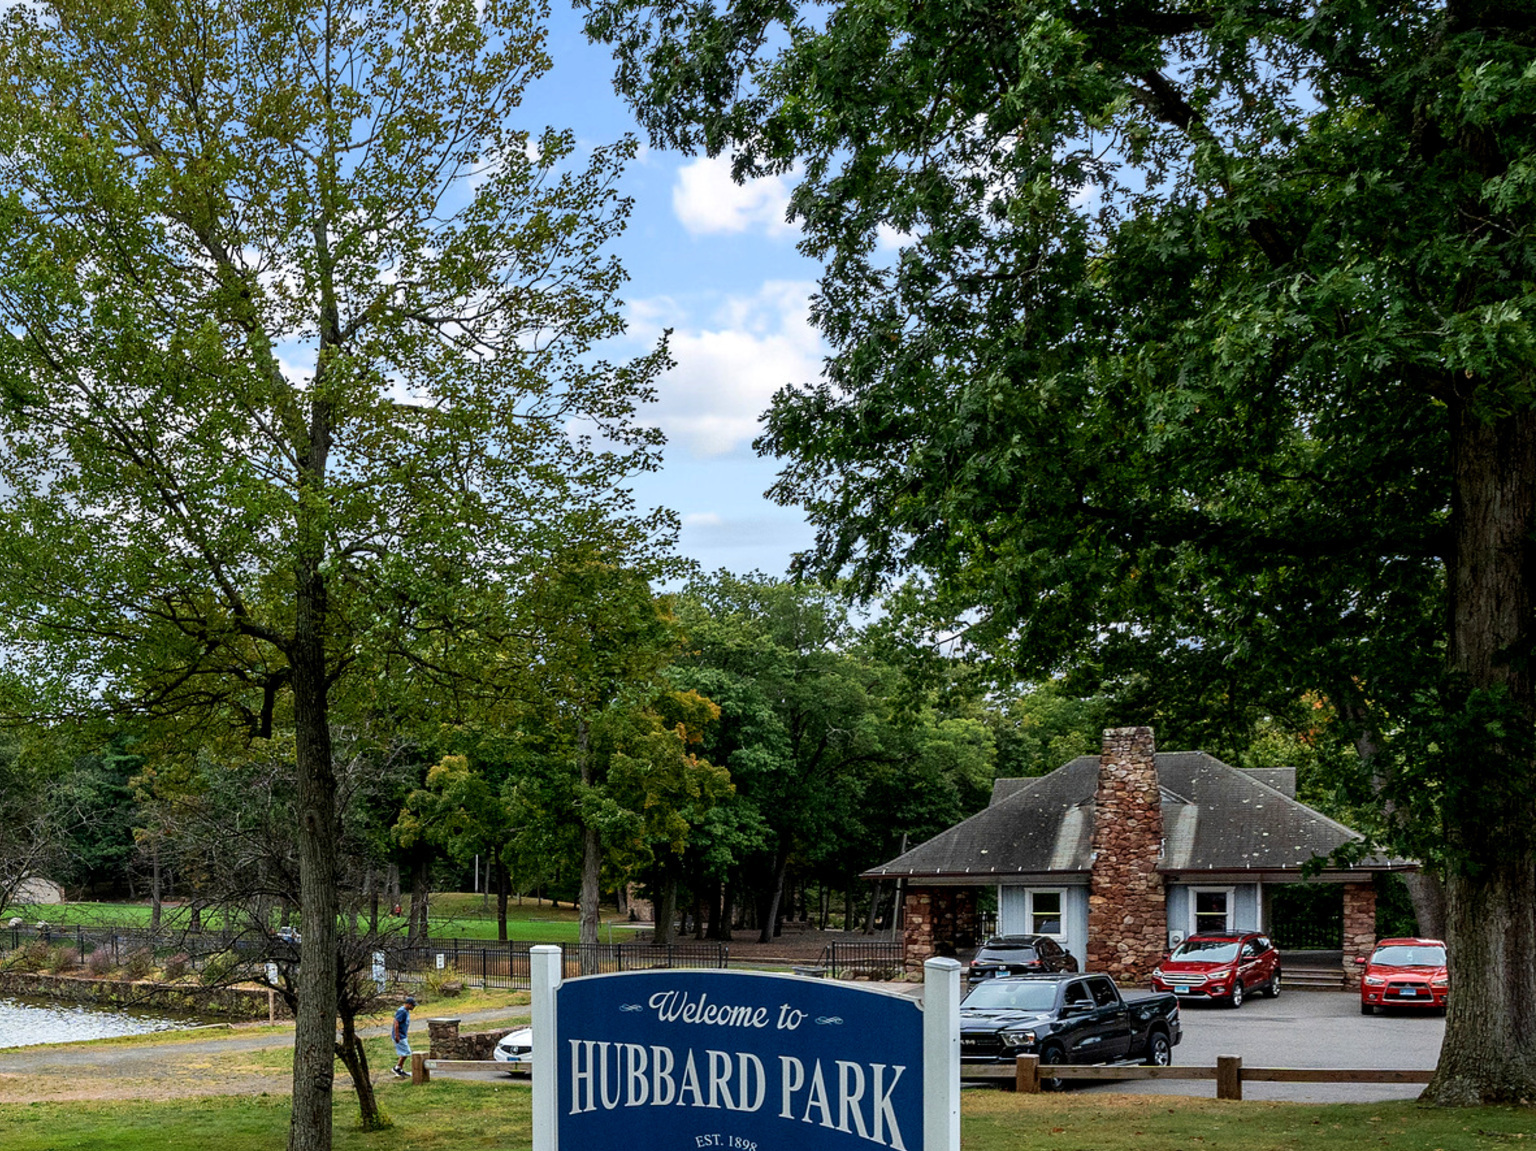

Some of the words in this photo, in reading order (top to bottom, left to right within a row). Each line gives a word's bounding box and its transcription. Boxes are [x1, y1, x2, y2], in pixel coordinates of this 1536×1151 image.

[648, 990, 769, 1028] Welcome
[777, 1003, 809, 1030] to
[568, 1039, 766, 1115] HUBBARD
[695, 1134, 724, 1148] EST.
